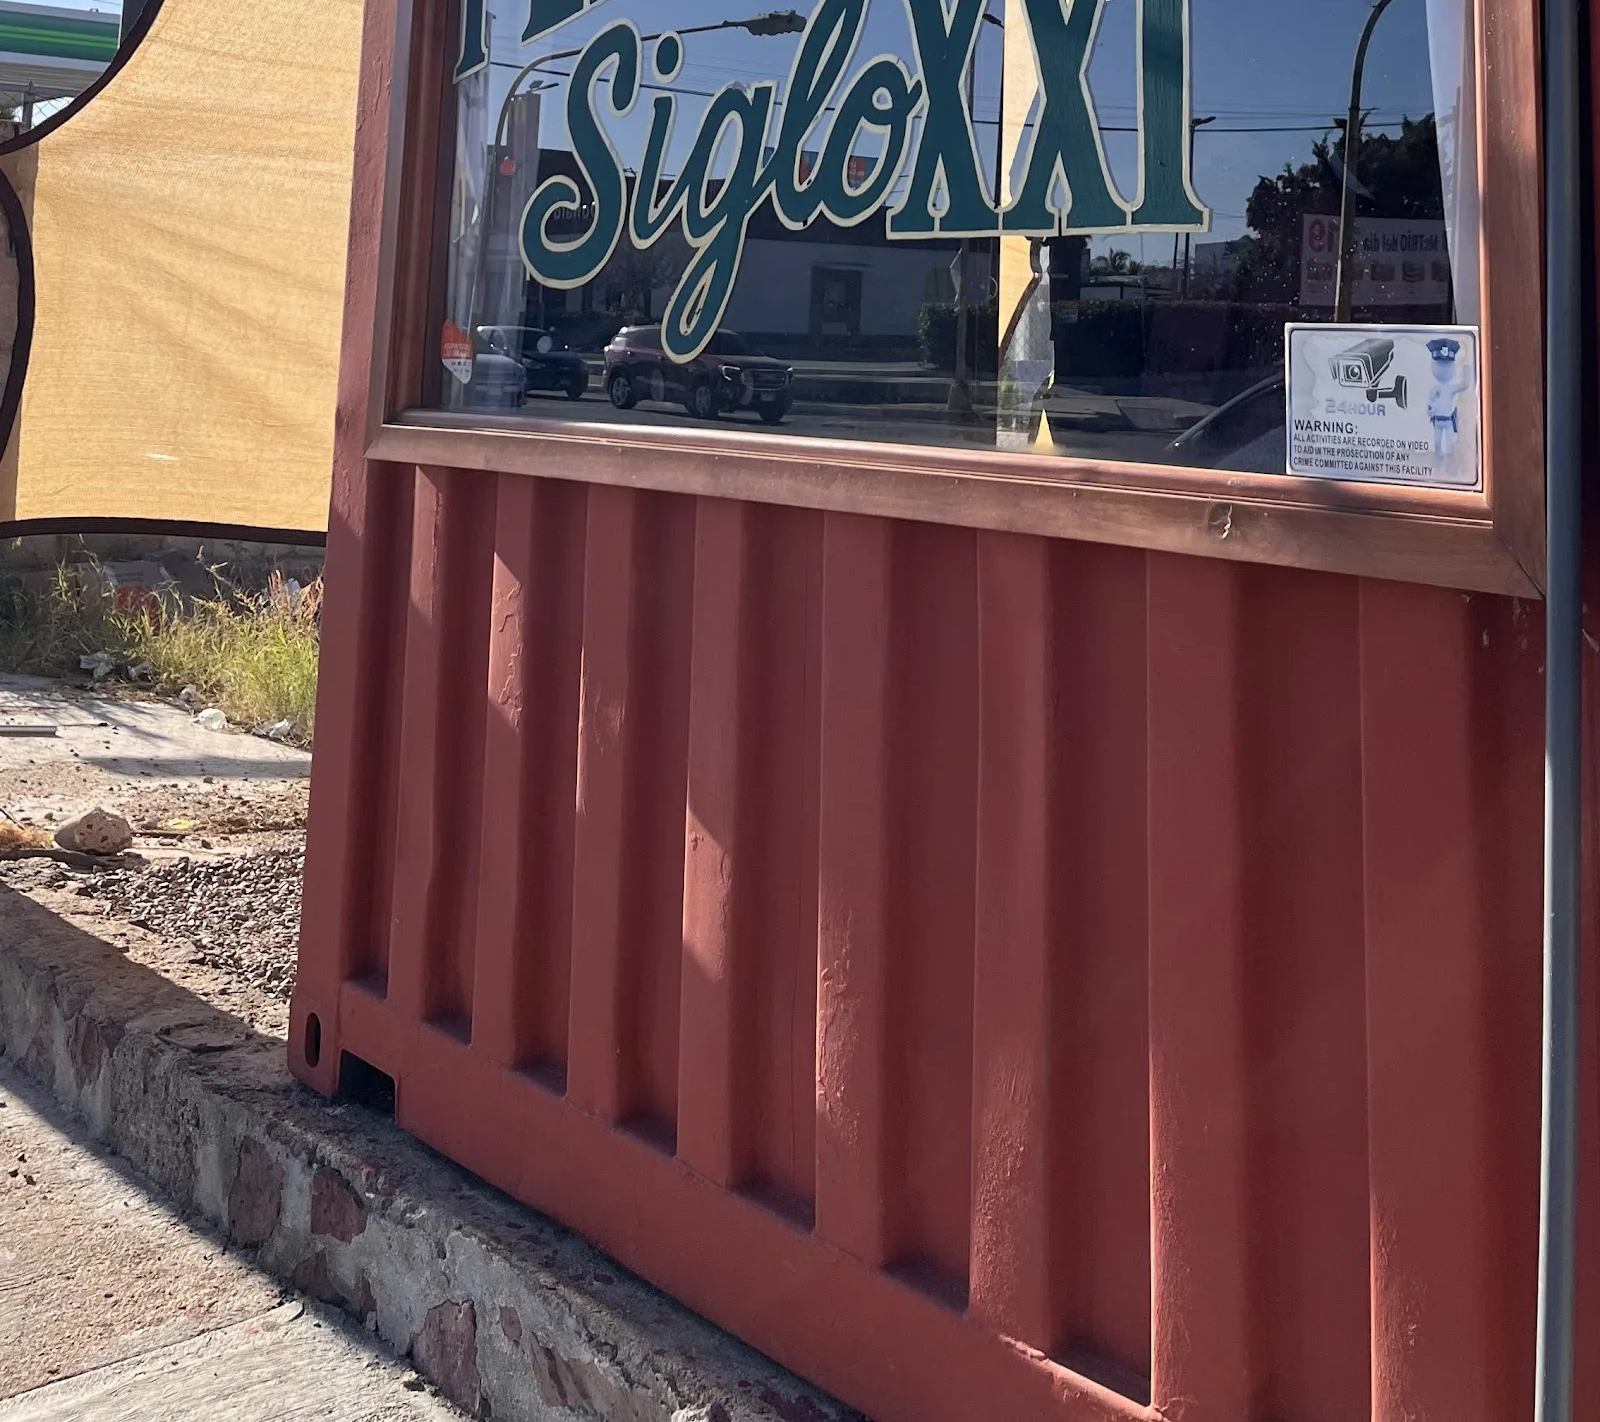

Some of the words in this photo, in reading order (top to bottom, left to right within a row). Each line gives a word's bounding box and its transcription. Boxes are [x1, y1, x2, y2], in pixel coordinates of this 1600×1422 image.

[1294, 419, 1358, 434] WARNING:
[1293, 433, 1306, 442] ALL
[1306, 433, 1342, 445] ACTIVITIES
[1343, 436, 1356, 446] ARE
[1358, 437, 1395, 448] RECORDED
[1396, 439, 1406, 449] ON
[1407, 441, 1429, 451] VIDEO
[1293, 444, 1302, 454] TO
[1303, 445, 1314, 455] AID
[1315, 446, 1322, 455] IN
[1323, 447, 1335, 456] THE
[1336, 447, 1384, 460] PROSECUTION
[1386, 451, 1395, 461] OF
[1396, 452, 1410, 462] ANY
[1293, 456, 1313, 467] CRIME
[1314, 458, 1354, 470] COMMITTED
[1354, 461, 1384, 472] AGAINST
[1385, 464, 1400, 474] THIS
[1402, 465, 1433, 476] FACILITY
